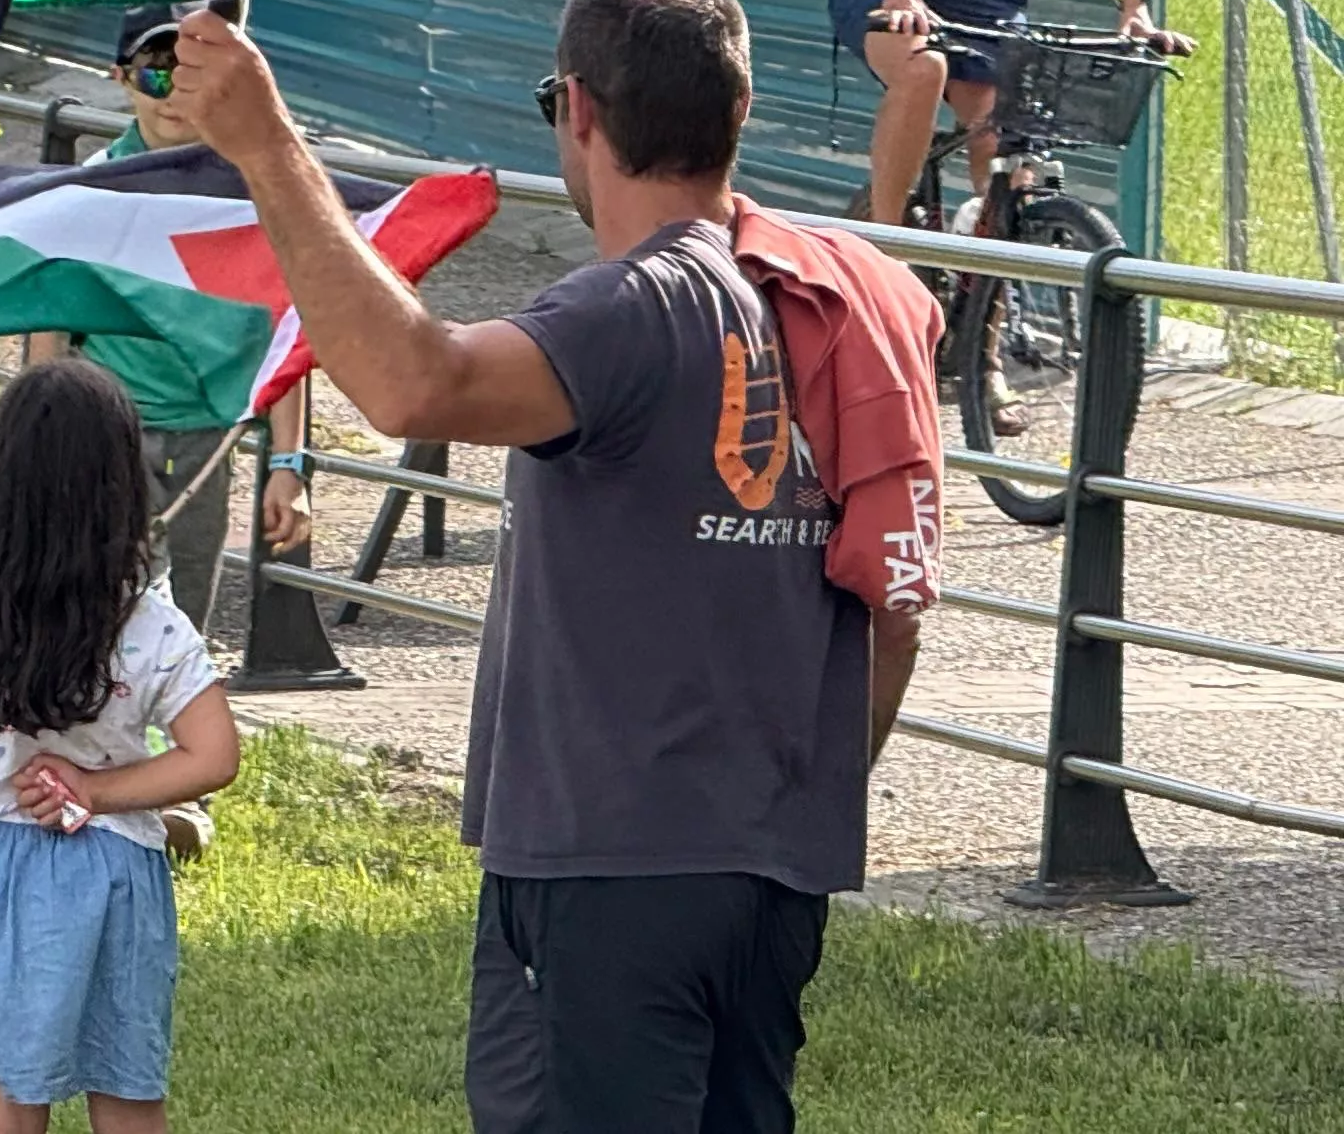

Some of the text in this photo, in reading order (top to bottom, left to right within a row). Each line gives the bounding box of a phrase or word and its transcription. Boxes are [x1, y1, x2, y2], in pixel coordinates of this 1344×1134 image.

[696, 514, 793, 547] SEARCH
[798, 518, 809, 546] &
[884, 530, 926, 614] FAC
